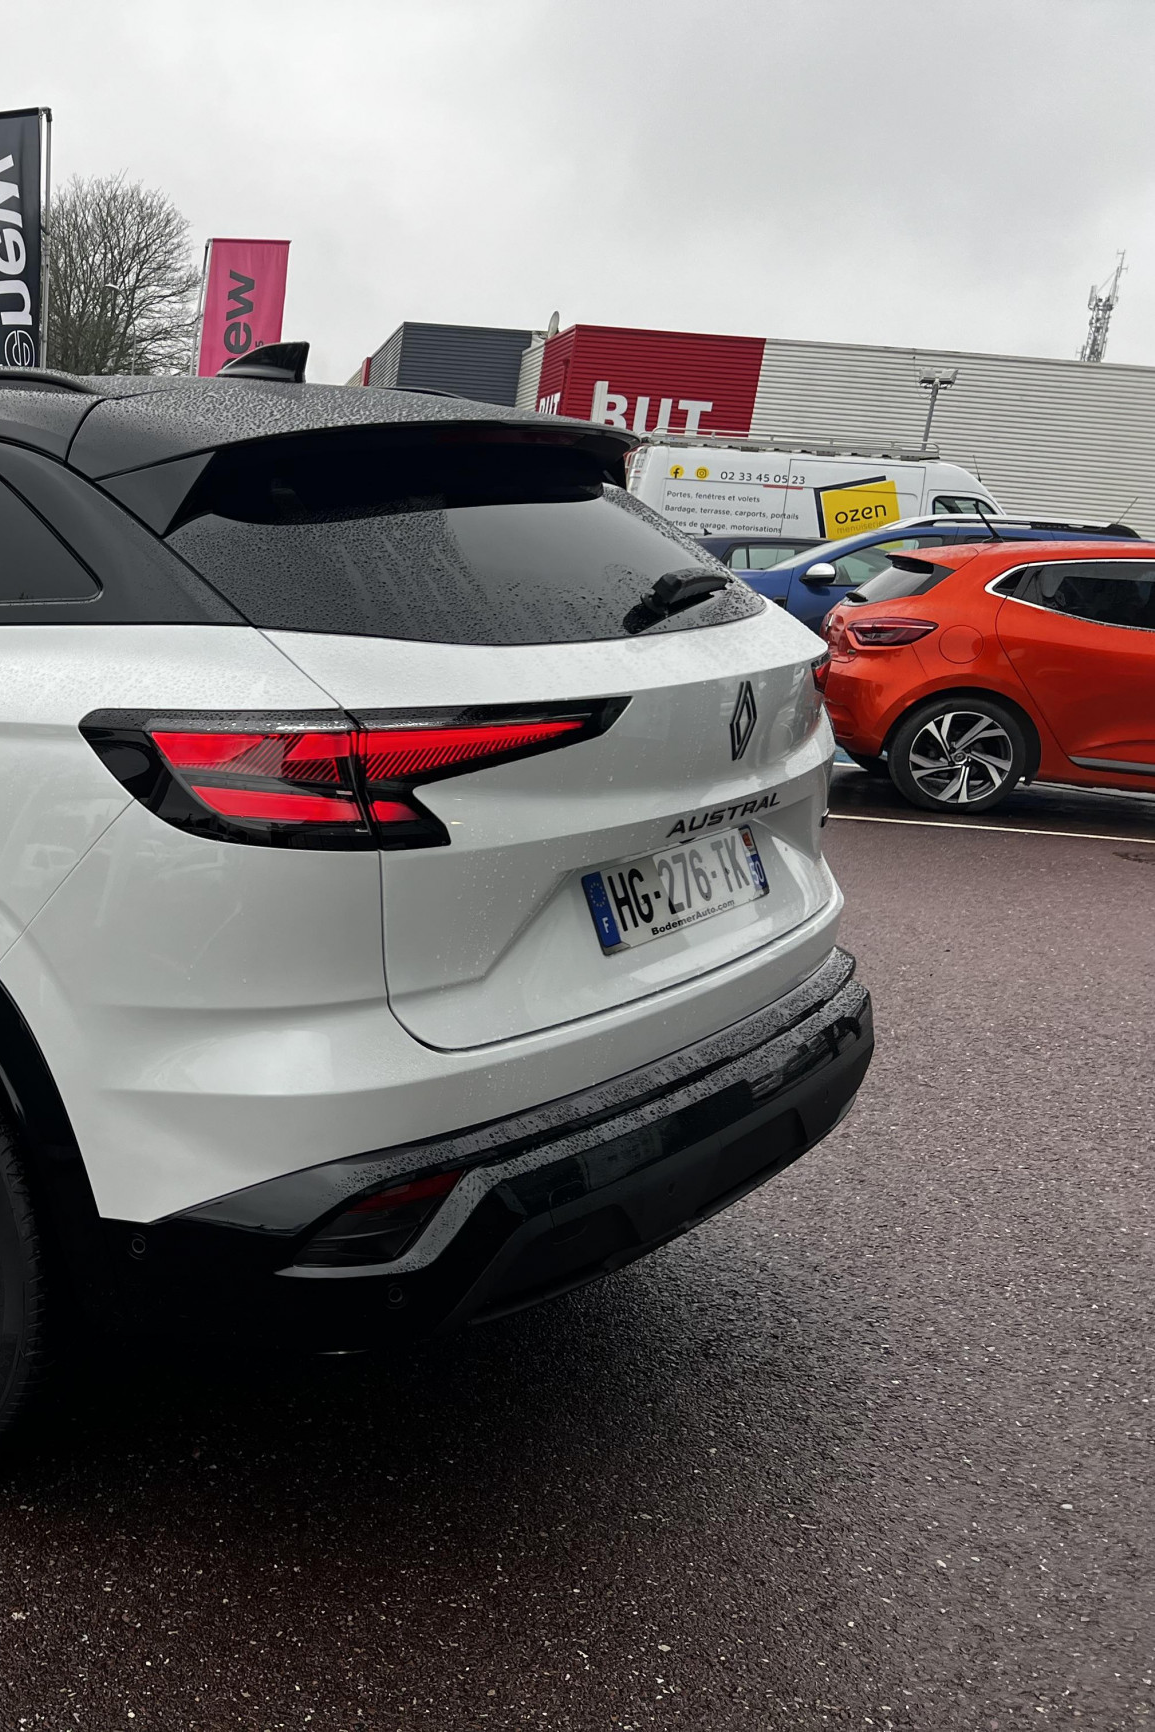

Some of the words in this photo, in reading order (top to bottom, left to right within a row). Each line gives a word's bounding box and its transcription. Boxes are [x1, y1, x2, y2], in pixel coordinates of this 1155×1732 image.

[590, 380, 714, 437] BUT
[720, 471, 735, 480] 02
[738, 472, 752, 481] 33
[755, 473, 770, 483] 45
[773, 475, 788, 484] 05
[791, 475, 806, 485] 23
[695, 492, 726, 501] fenêtres
[738, 495, 761, 503] volets
[665, 504, 697, 514] Bardage,
[770, 511, 799, 520] portails
[834, 503, 887, 525] ozen
[730, 524, 782, 534] motorisations
[836, 520, 884, 535] menuiserie
[666, 793, 781, 838] AUSTRAL
[749, 861, 765, 885] 50
[607, 835, 750, 932] HG-276-TK
[602, 916, 610, 934] F
[651, 899, 735, 936] BodemerAuto.com
